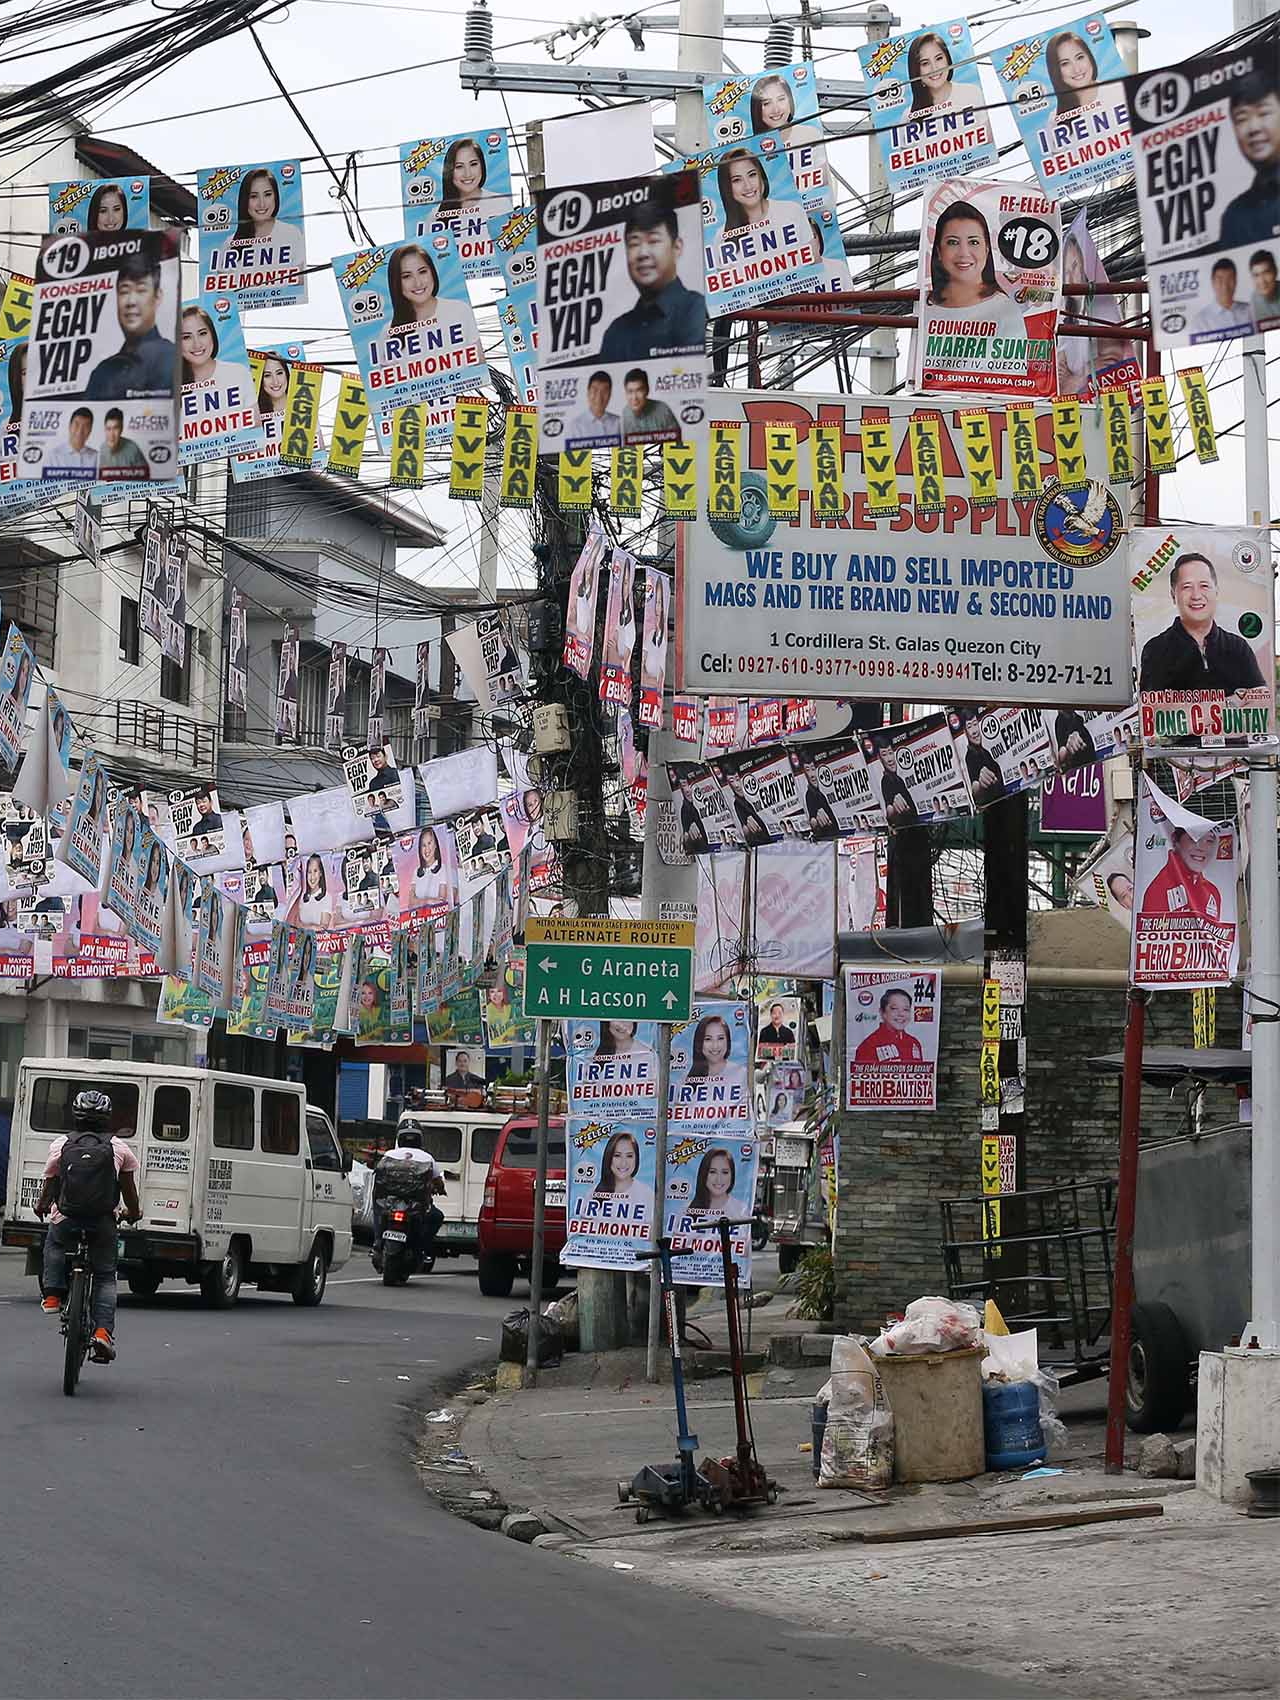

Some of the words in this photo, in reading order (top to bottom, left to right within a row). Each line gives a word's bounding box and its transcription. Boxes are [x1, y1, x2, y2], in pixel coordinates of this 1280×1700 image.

[1139, 79, 1178, 116] #19
[890, 102, 976, 146] IRENE
[889, 125, 988, 171] BELMONTE
[1146, 127, 1220, 197] EGAY
[547, 197, 581, 231] #19
[596, 186, 649, 214] IBOTO!
[1000, 196, 1056, 214] RE-ELECT
[1155, 181, 1215, 245] YAP
[46, 244, 80, 274] #19
[93, 239, 142, 261] IBOTO!
[544, 230, 620, 261] KONSEHAL
[1004, 226, 1052, 260] #18
[40, 277, 114, 299] KONSEHAL
[544, 248, 614, 306] EGAY
[35, 293, 107, 341] EGAY
[549, 298, 603, 353] YAP
[928, 320, 996, 336] COUNCILOR
[371, 323, 465, 364] IRENE
[926, 336, 987, 358] MARRA
[38, 339, 92, 386] YAP
[369, 346, 478, 388] BELMONTE
[925, 360, 966, 368] DISTRICT
[988, 361, 1027, 370] QUEZON
[984, 378, 1013, 386] MARRA
[1015, 379, 1035, 387] (SBP)
[456, 411, 483, 479] IVY
[770, 435, 795, 500] IVY
[816, 429, 838, 509] LAGMAN
[916, 423, 940, 502] LAGMAN
[889, 492, 1038, 537] SUPPLY
[746, 552, 783, 579] WE
[792, 552, 837, 580] BUY
[847, 555, 896, 583] AND
[905, 557, 952, 585] SELL
[961, 559, 1074, 589] IMPORTED
[1046, 543, 1082, 564] PHILIPPINE
[1085, 547, 1109, 564] EAGLES
[1131, 535, 1181, 591] RE-ELECT
[705, 583, 756, 607] MAGS
[763, 584, 801, 609] AND
[809, 585, 844, 610] TIRE
[851, 587, 911, 612] BRAND
[918, 590, 959, 614] NEW
[967, 592, 982, 615] &
[991, 592, 1056, 618] SECOND
[1063, 595, 1111, 619] HAND
[1243, 615, 1259, 635] 2
[771, 633, 779, 646] 1
[785, 633, 863, 649] Cordillera
[869, 636, 890, 650] St.
[895, 635, 940, 653] Galas
[945, 638, 1004, 655] Quezon
[1010, 641, 1041, 658] City
[701, 654, 732, 673] Cel:
[1008, 663, 1112, 685] 8-292-71-21
[1141, 689, 1225, 703] CONGRESSMAN
[1143, 704, 1187, 736] BONG
[1191, 706, 1208, 735] C.
[1211, 704, 1268, 735] SUNTAY
[346, 761, 368, 779] EGAY
[351, 776, 368, 793] YAP
[544, 930, 620, 942] ALTERNATE
[631, 932, 676, 943] ROUTE
[582, 958, 592, 976] G
[602, 959, 680, 977] Araneta
[1140, 972, 1168, 980] DISTRICT
[1178, 972, 1204, 980] QUEZON
[538, 988, 549, 1004] A
[560, 988, 570, 1005] H
[580, 989, 646, 1008] Lacson
[914, 978, 935, 1002] #4
[985, 988, 998, 1031] IVY
[577, 1063, 648, 1080] IRENE
[573, 1083, 654, 1099] BELMONTE
